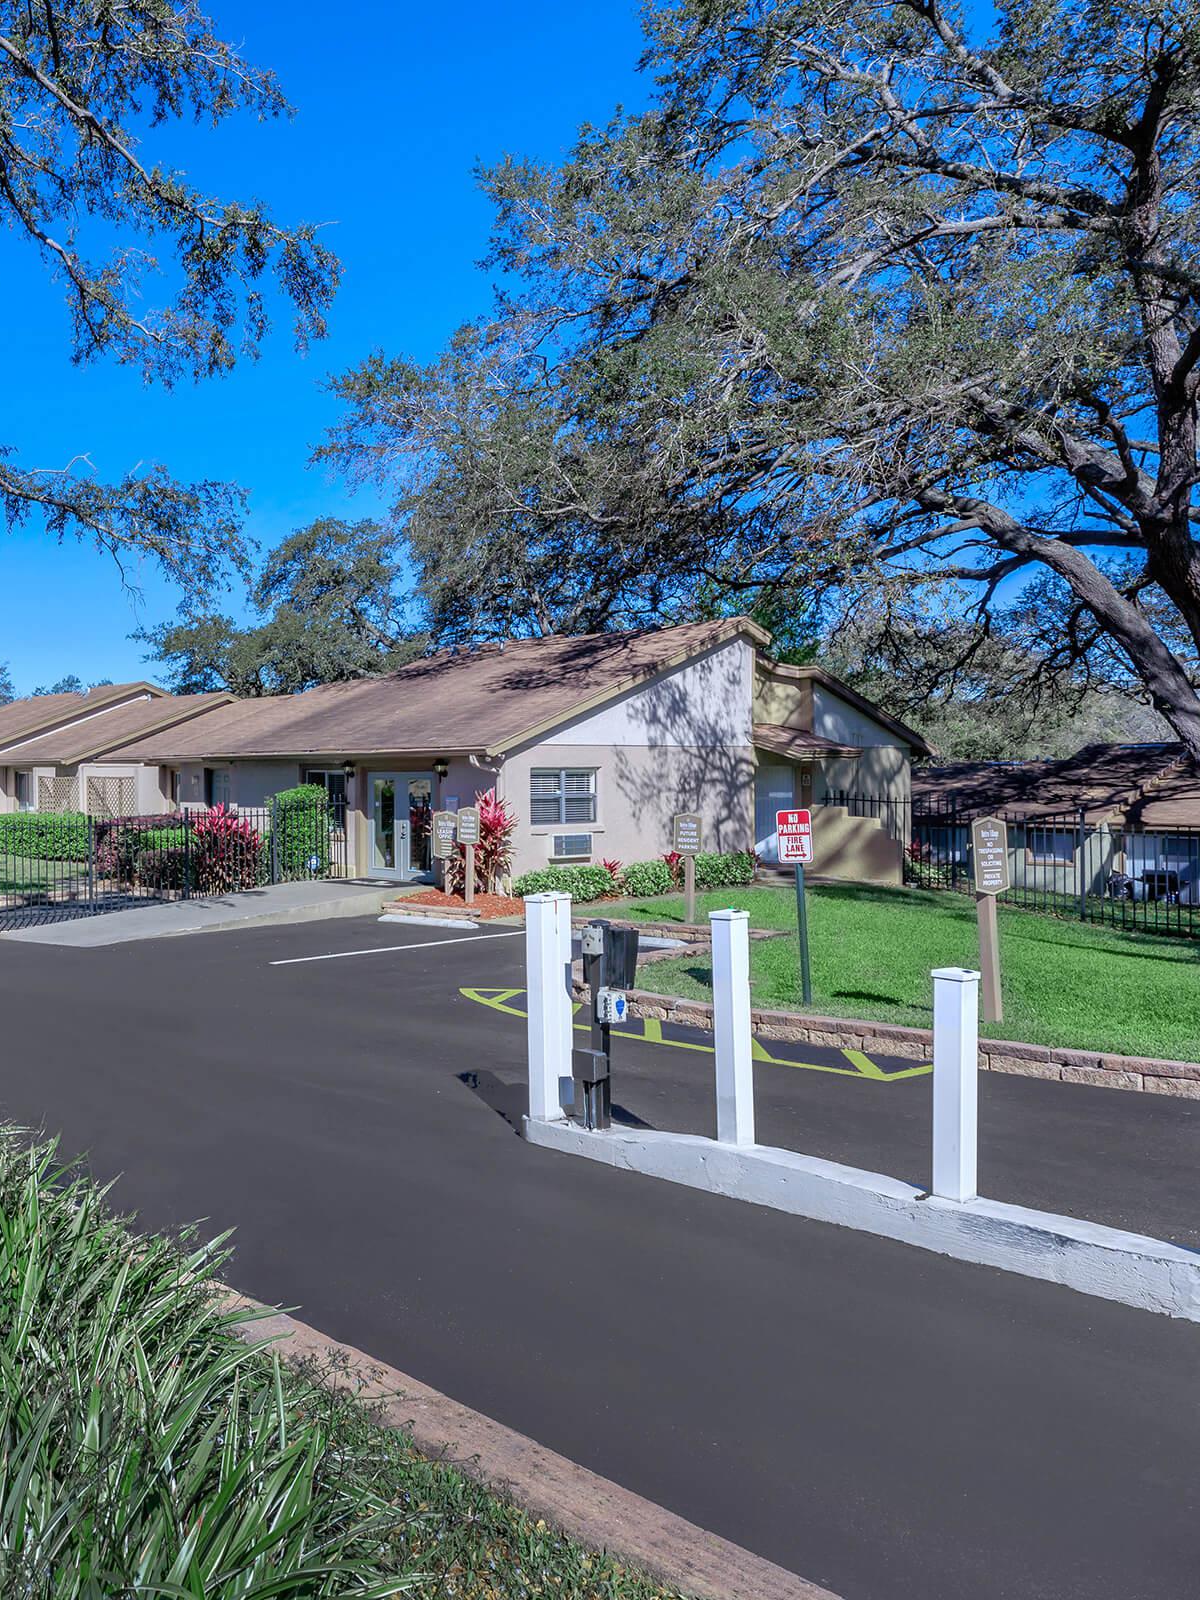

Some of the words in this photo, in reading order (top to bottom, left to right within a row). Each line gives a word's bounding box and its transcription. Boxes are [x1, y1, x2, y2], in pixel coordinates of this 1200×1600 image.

[788, 814, 798, 823] NO
[779, 824, 810, 833] PARKING
[787, 836, 803, 844] FIRE
[786, 844, 804, 852] LANE
